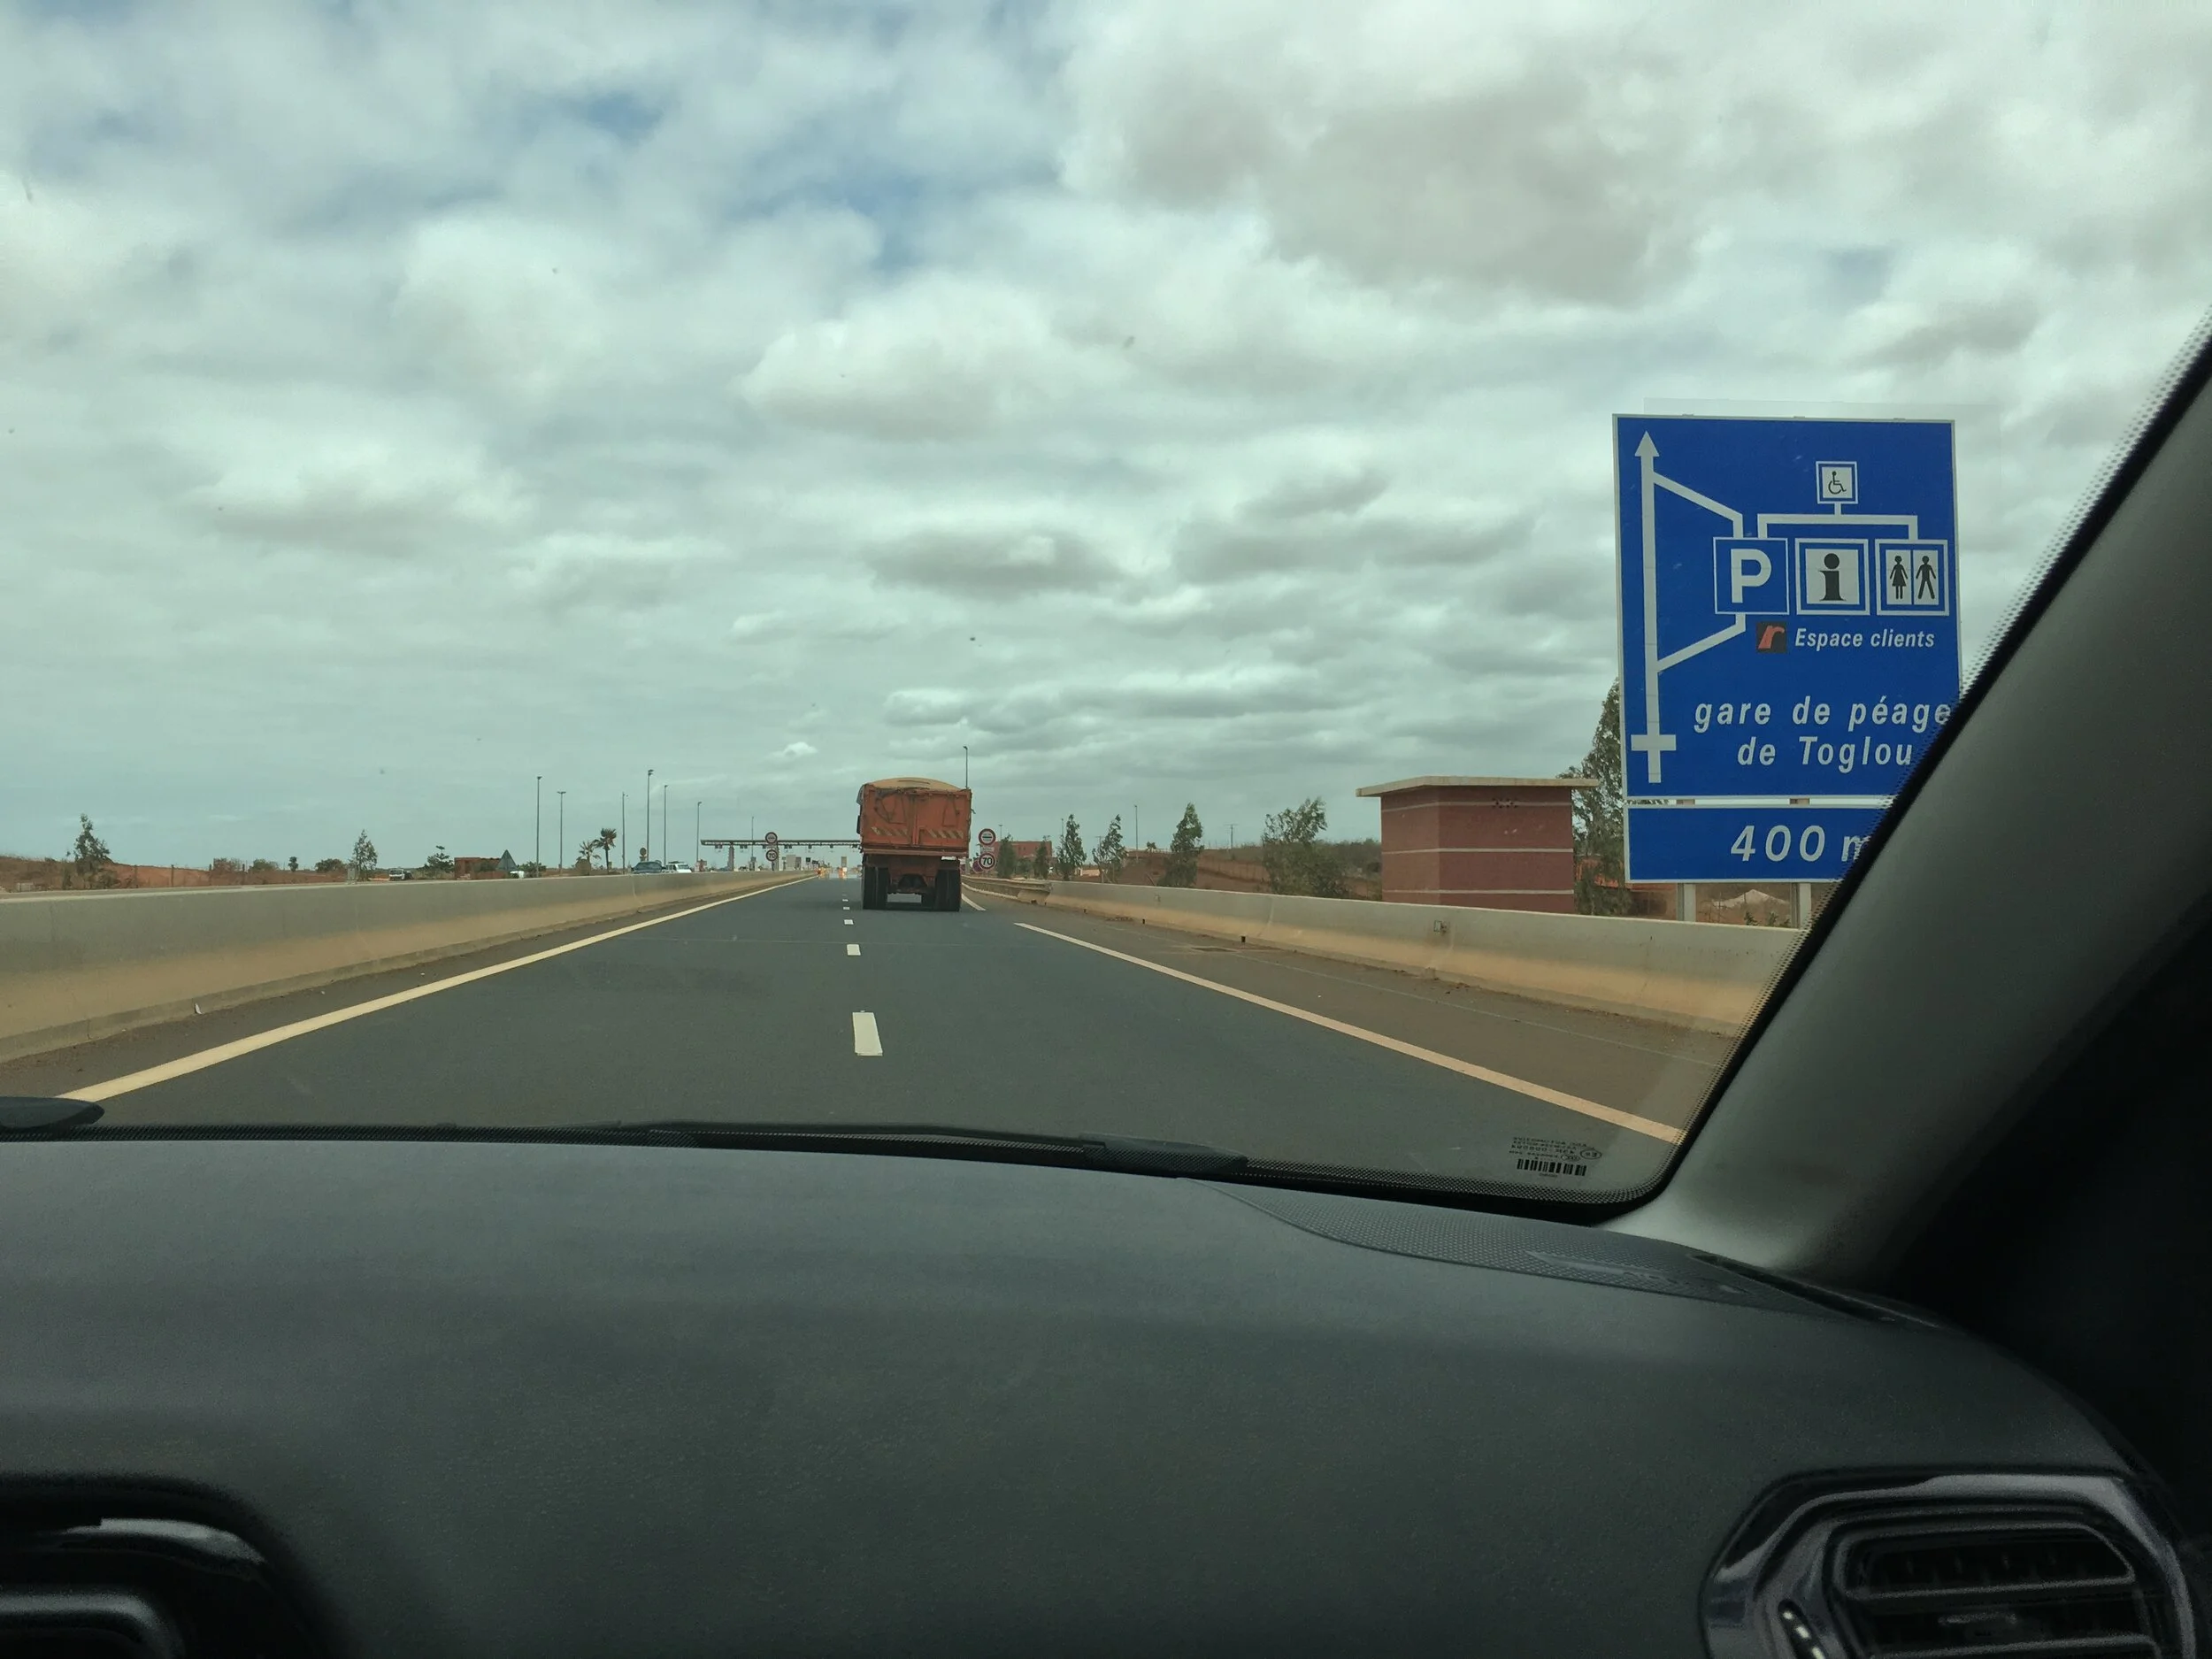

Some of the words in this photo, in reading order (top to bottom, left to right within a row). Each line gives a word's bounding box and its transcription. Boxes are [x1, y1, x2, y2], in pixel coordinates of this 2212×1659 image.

[1731, 549, 1772, 603] P
[1795, 628, 1863, 652] Espace
[1870, 628, 1935, 648] clients
[1694, 703, 1771, 733] gare
[1792, 695, 1831, 725] de
[1847, 695, 1951, 733] péage
[1737, 736, 1776, 765] de
[1799, 736, 1913, 773] Toglou
[982, 856, 993, 866] 70
[1730, 825, 1826, 862] 400
